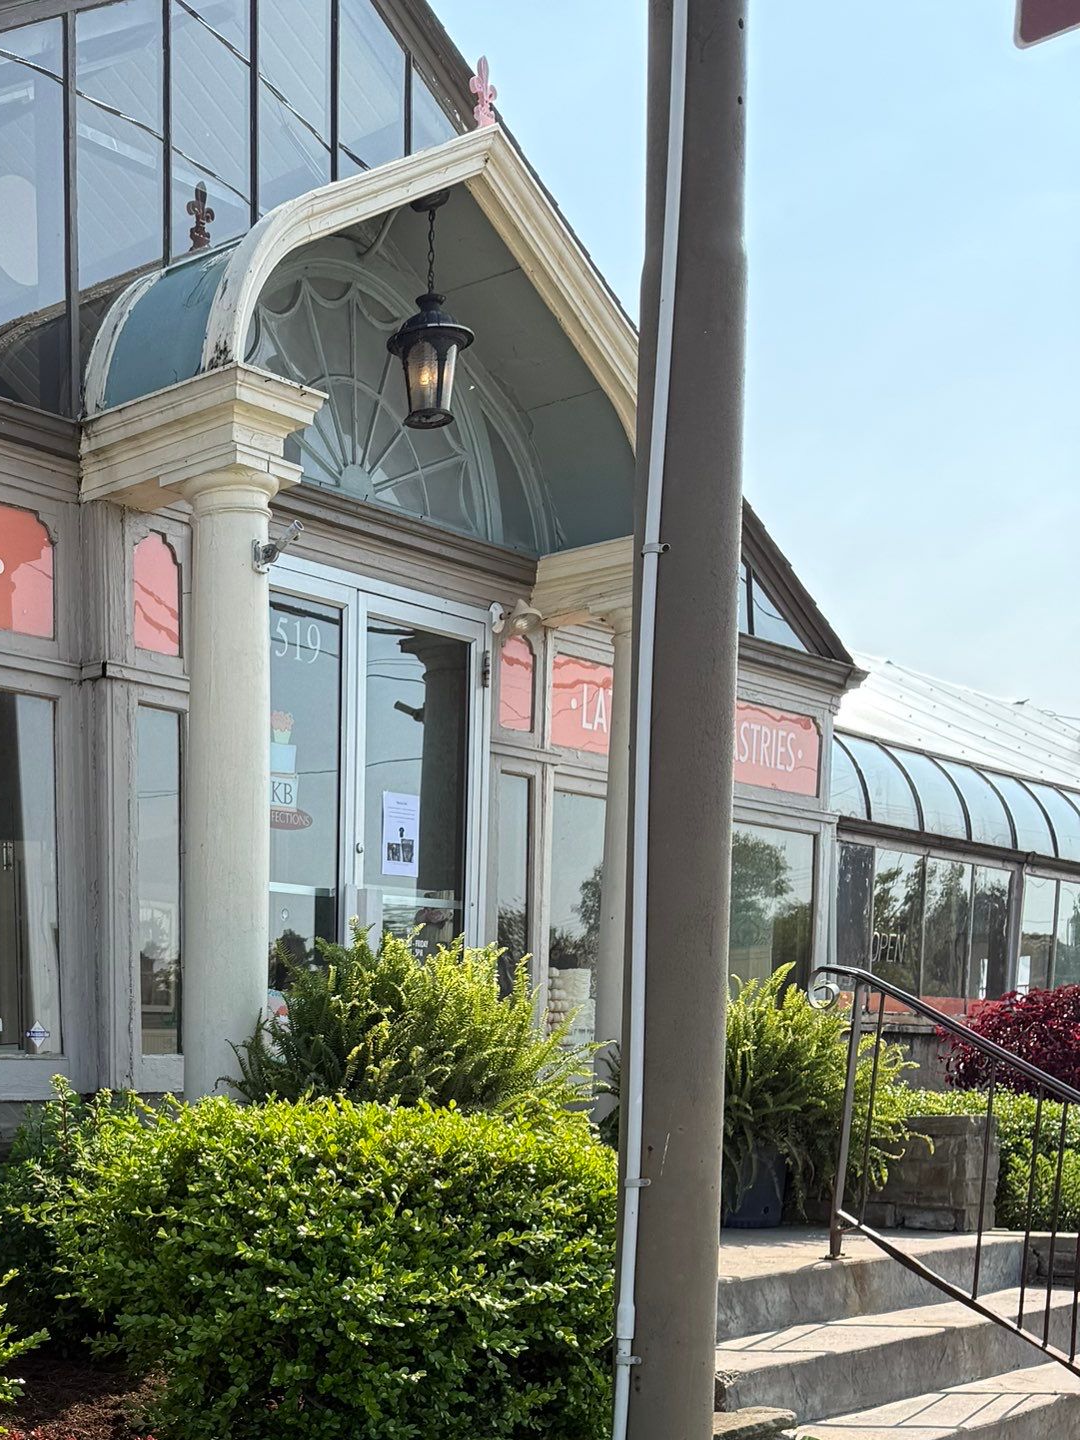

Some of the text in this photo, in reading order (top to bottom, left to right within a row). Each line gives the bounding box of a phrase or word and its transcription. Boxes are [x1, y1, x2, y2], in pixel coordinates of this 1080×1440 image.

[275, 616, 321, 664] 519
[582, 683, 612, 733] LA
[734, 721, 796, 772] STRIES
[271, 780, 293, 805] KB
[271, 810, 311, 827] FECTIONS
[871, 931, 907, 963] OPEN
